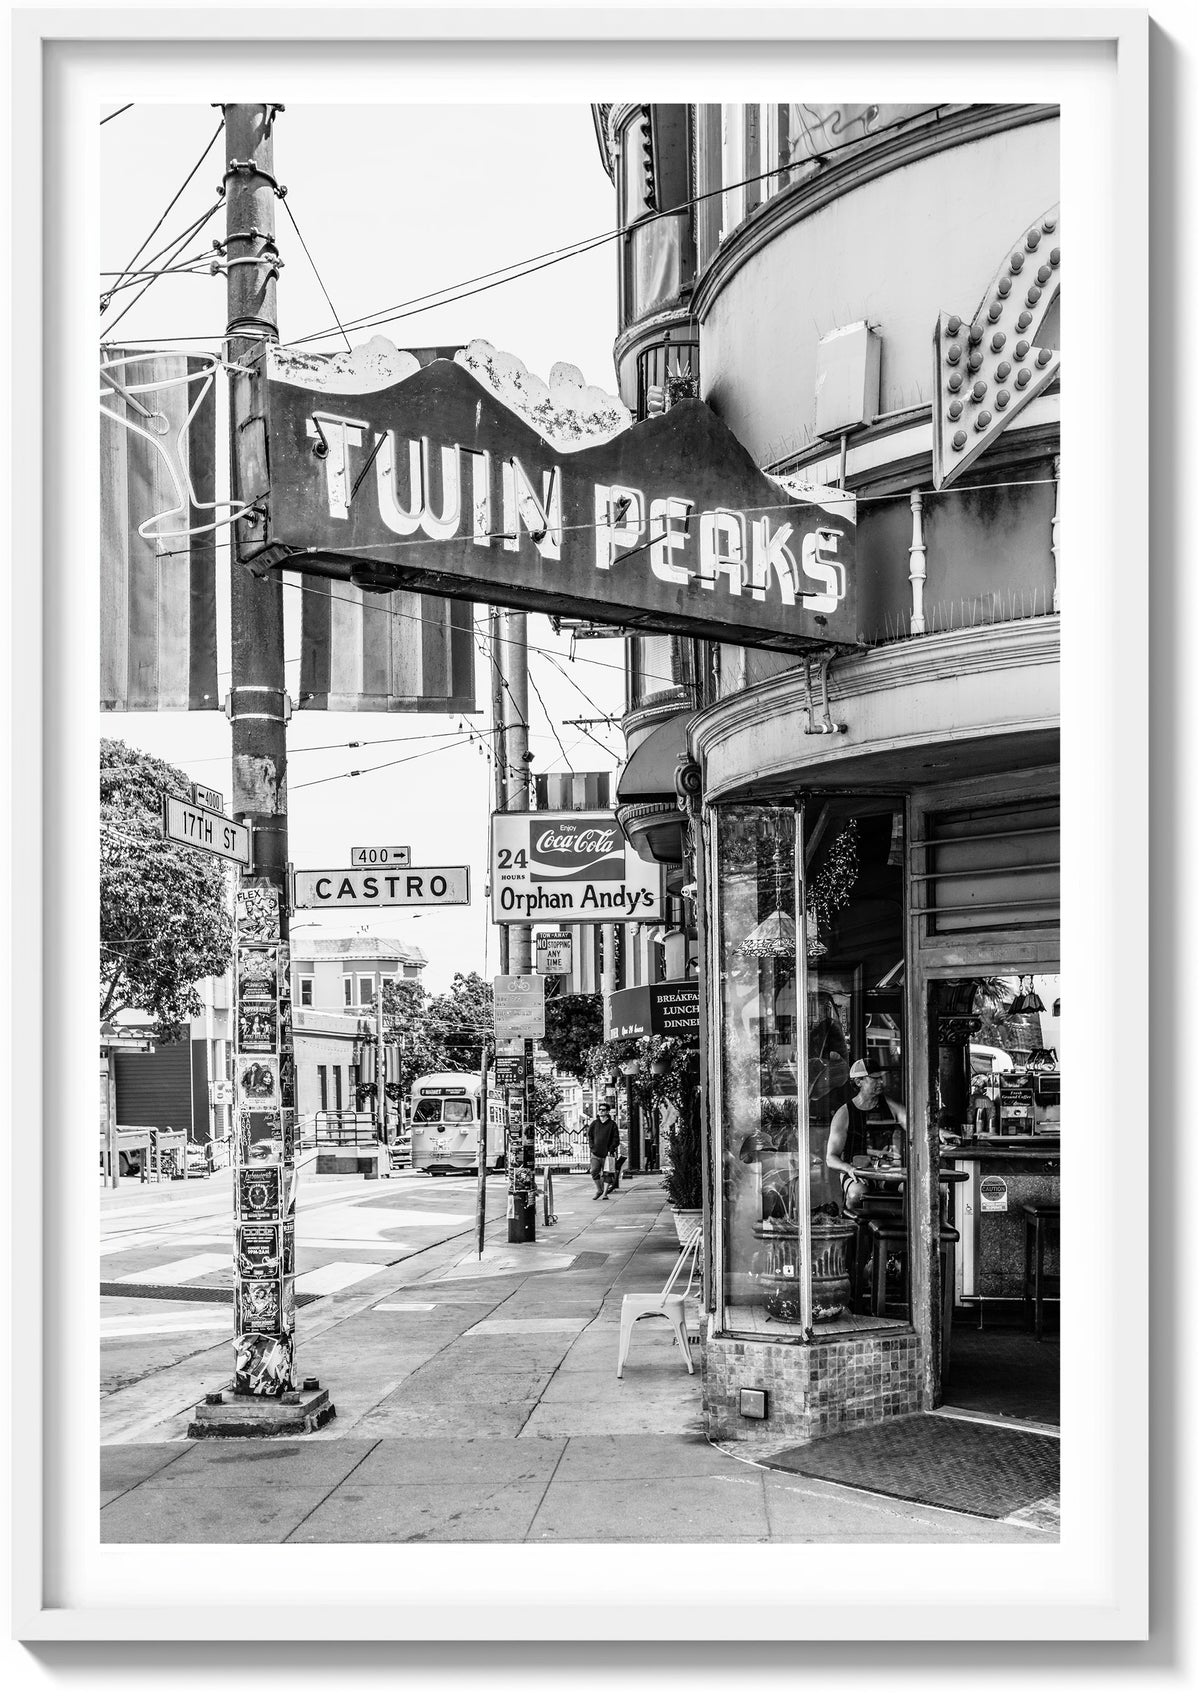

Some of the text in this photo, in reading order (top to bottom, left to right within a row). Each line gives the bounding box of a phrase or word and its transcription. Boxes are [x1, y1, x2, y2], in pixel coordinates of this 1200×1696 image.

[305, 411, 847, 614] TWIN PEAKS
[183, 811, 236, 851] 17TH ST
[559, 824, 577, 833] Enjoy
[536, 828, 617, 854] Coca-Cola
[358, 848, 389, 864] 400
[497, 848, 529, 870] 24
[501, 873, 526, 881] HOURS
[315, 875, 448, 900] CASTRO
[237, 889, 261, 902] FLEX
[500, 885, 655, 917] Orphan Andy's
[537, 938, 571, 949] NO STOPPING
[547, 950, 561, 958] ANY
[546, 958, 562, 967] TIME
[657, 993, 700, 1003] BREAKFA
[663, 1004, 700, 1015] LUNCH
